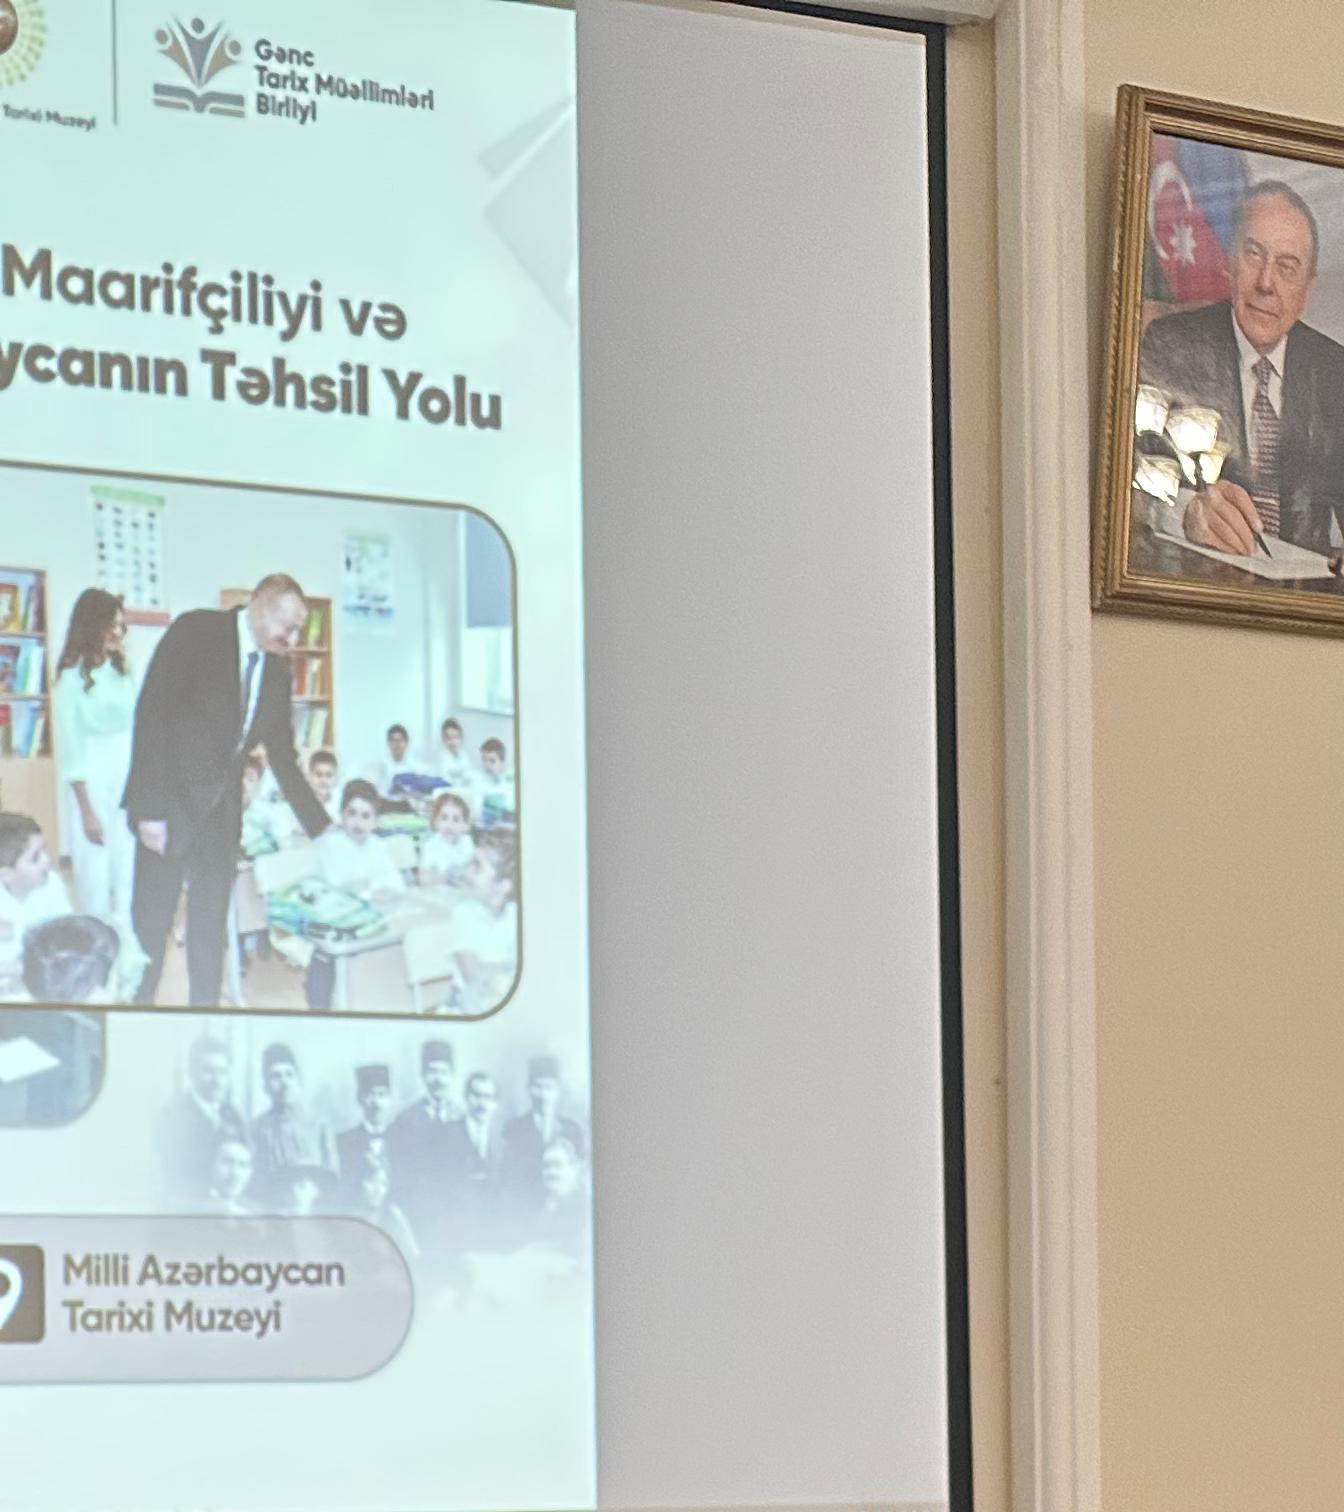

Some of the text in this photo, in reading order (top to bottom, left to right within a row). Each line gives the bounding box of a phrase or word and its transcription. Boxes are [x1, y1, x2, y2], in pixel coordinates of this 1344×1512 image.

[255, 38, 315, 67] Gənc
[254, 64, 435, 111] Tarix Müəllimləri
[256, 92, 317, 125] Birliyi
[2, 243, 323, 342] Maarifçiliyi
[338, 295, 408, 341] və
[200, 348, 369, 416] Təhsil
[382, 367, 502, 430] Yolu
[62, 1253, 345, 1293] Milli Azərbaycan
[62, 1300, 282, 1339] Tarixi Muzeyi
